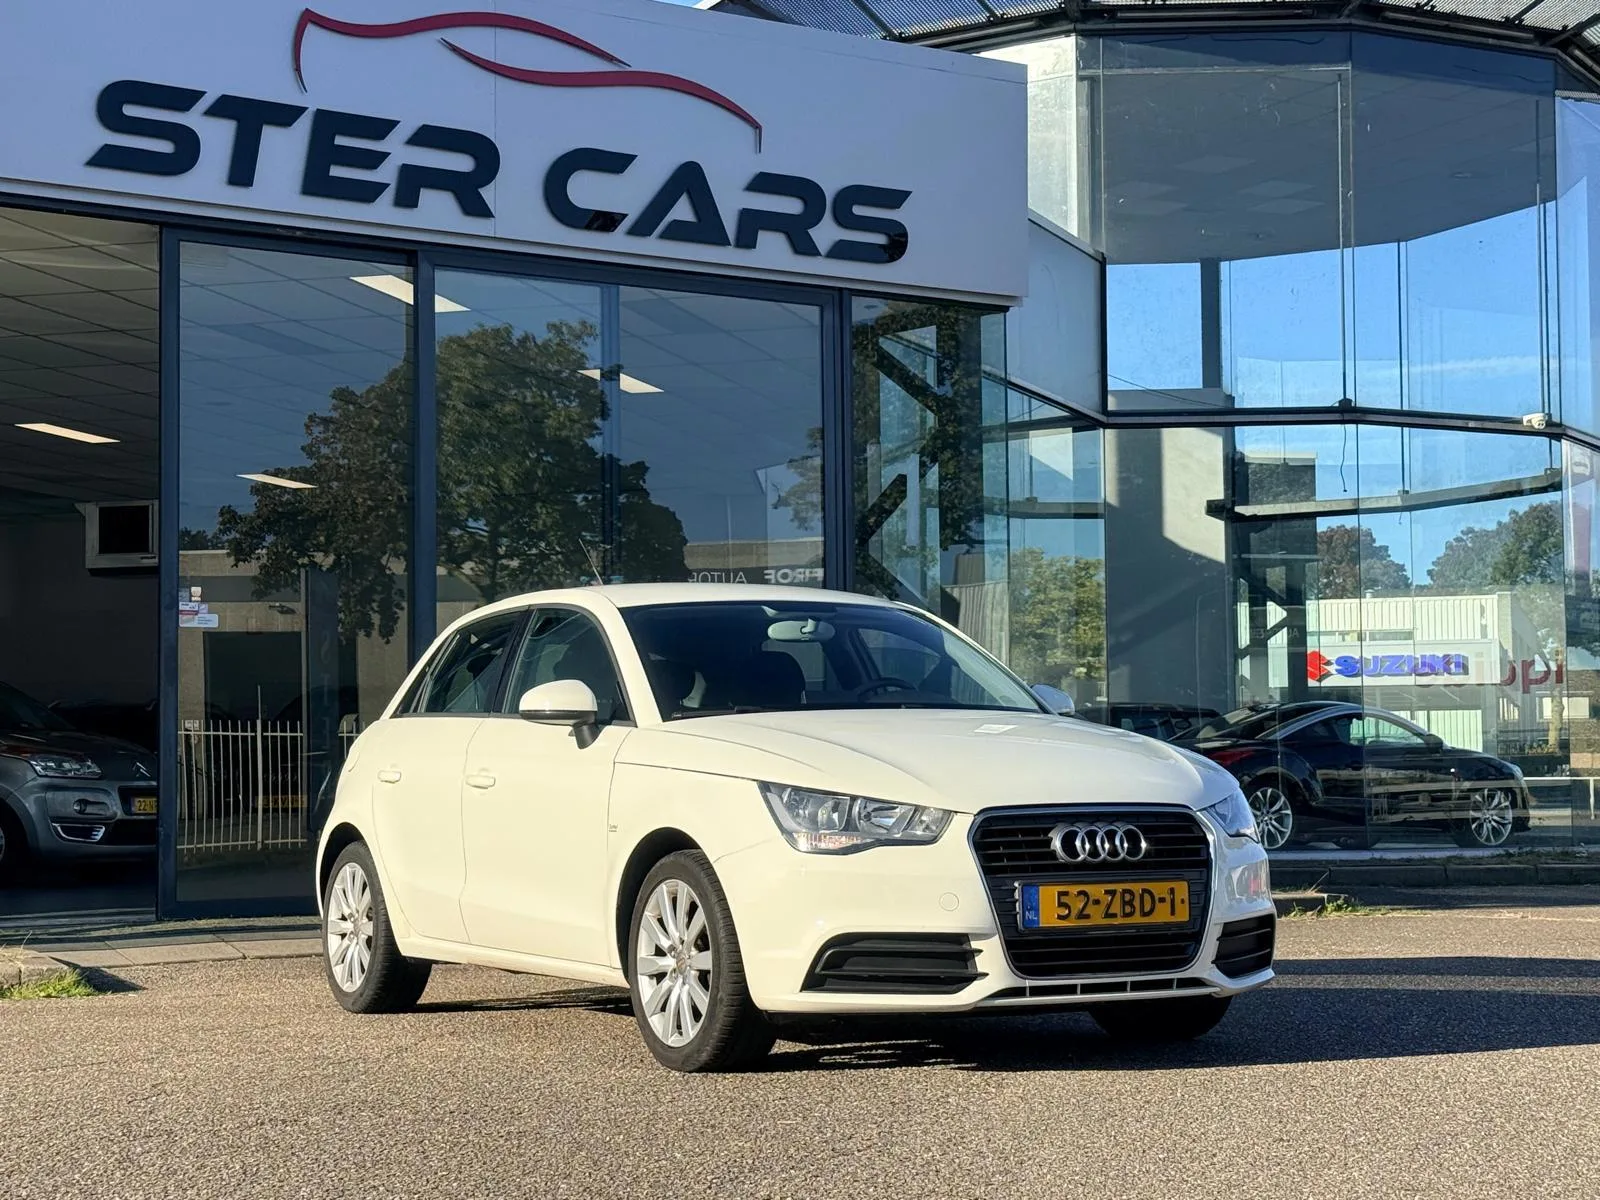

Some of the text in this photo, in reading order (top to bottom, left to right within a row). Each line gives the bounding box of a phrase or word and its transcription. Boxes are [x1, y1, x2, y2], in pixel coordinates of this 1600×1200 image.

[84, 79, 912, 264] STER CARS
[1334, 654, 1469, 678] SUZUKI
[1025, 886, 1177, 921] NL 52-ZBD-1
